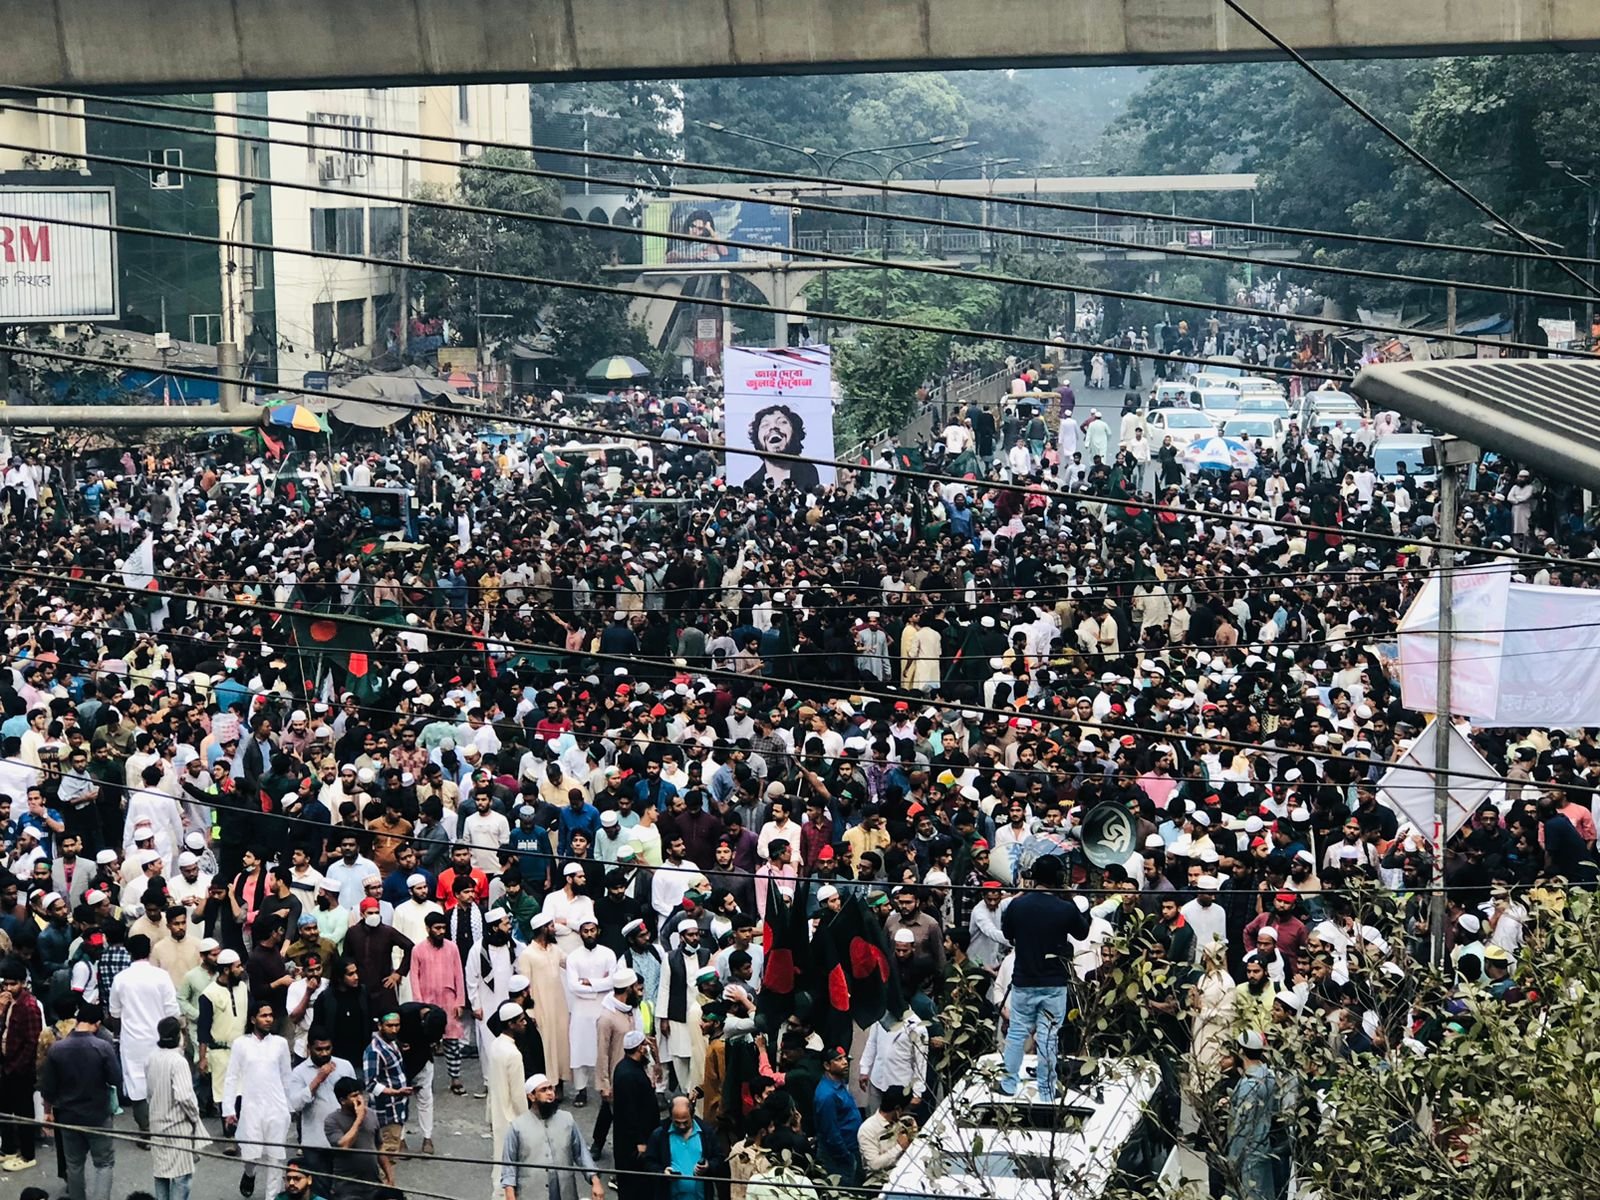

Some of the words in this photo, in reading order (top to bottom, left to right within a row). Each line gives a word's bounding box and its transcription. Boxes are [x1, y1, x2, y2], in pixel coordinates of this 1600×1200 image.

[14, 270, 51, 288] শিখরে
[755, 370, 777, 378] জান
[779, 369, 803, 380] দেবো
[746, 378, 776, 390] জুলাই
